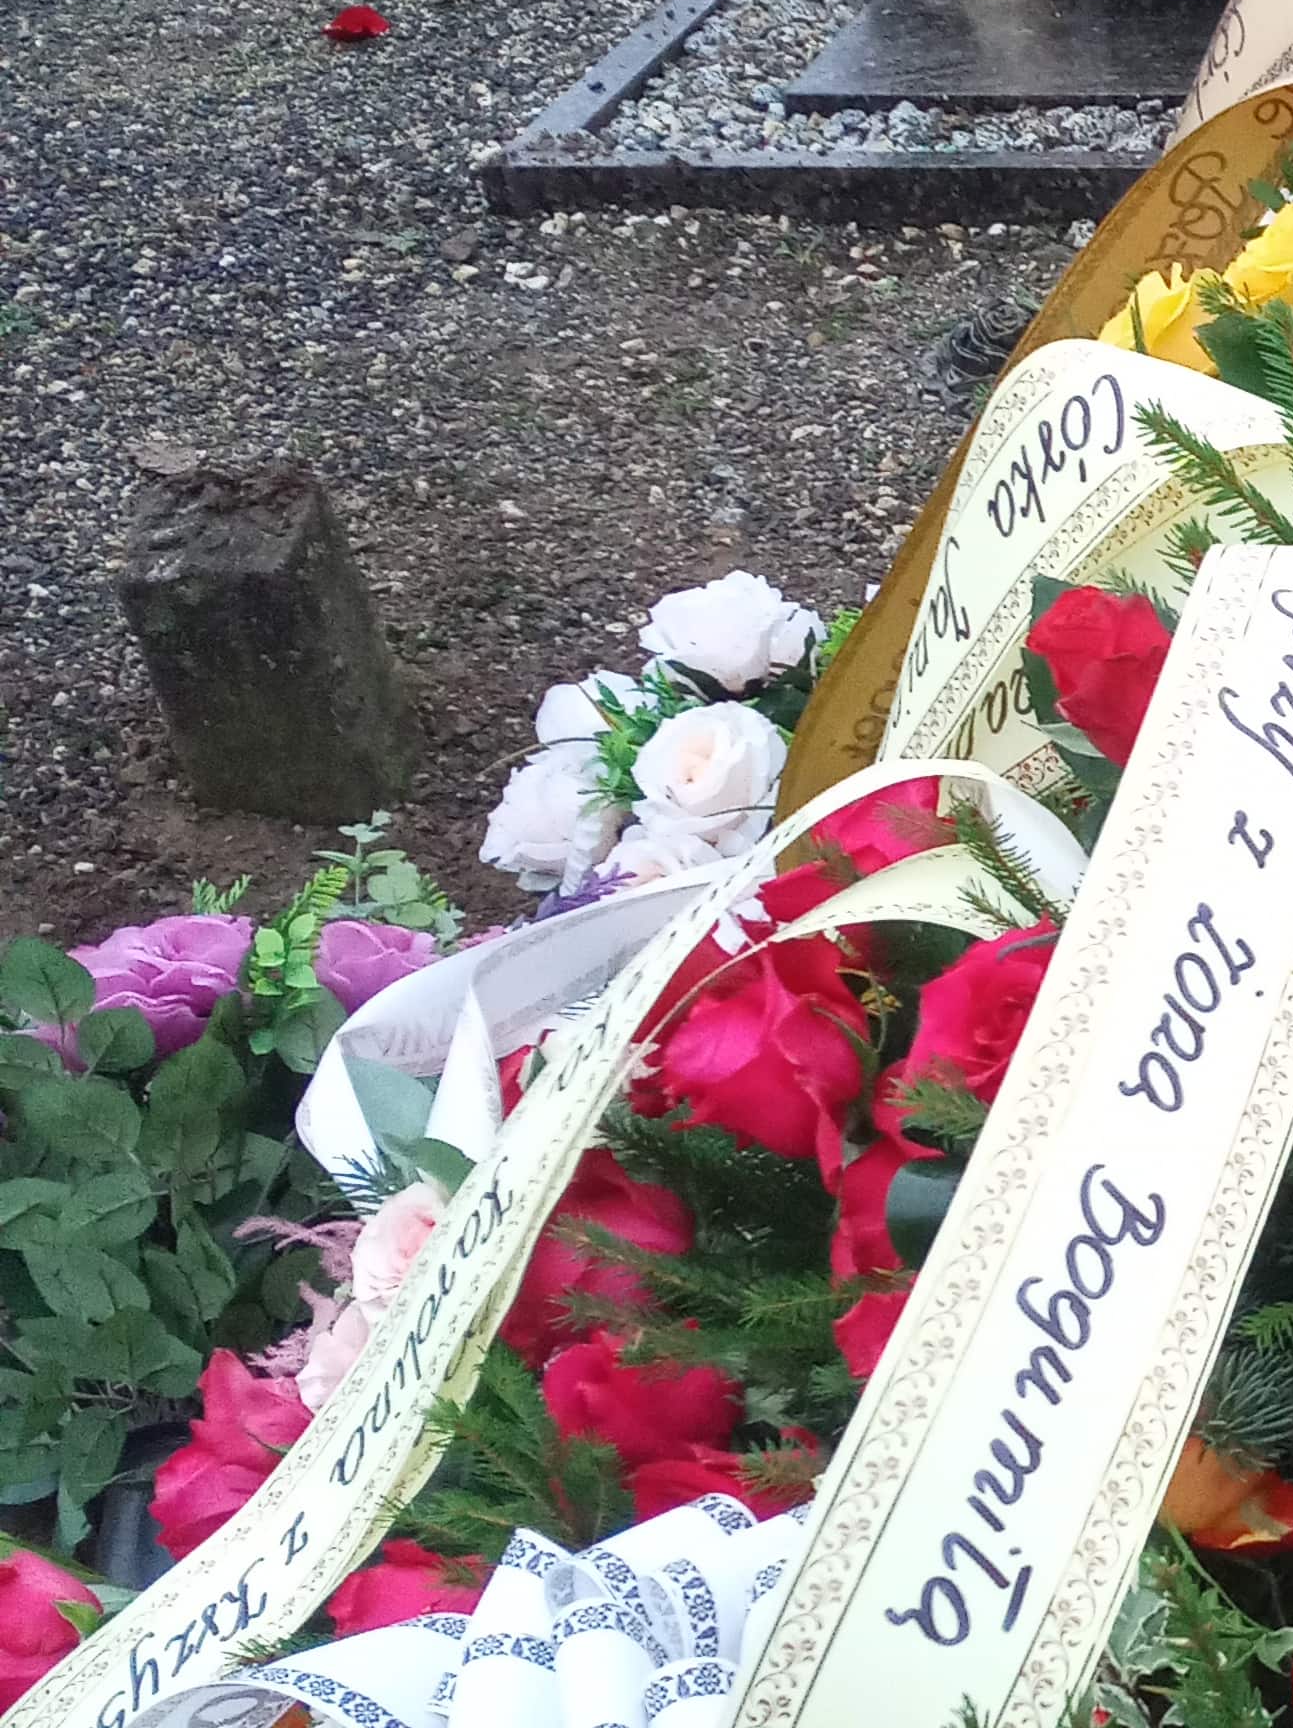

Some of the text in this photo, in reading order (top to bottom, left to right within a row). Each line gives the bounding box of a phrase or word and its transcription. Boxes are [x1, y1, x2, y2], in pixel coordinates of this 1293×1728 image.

[988, 374, 1126, 539] Córka
[1229, 810, 1275, 870] z
[331, 1155, 514, 1488] Karolina
